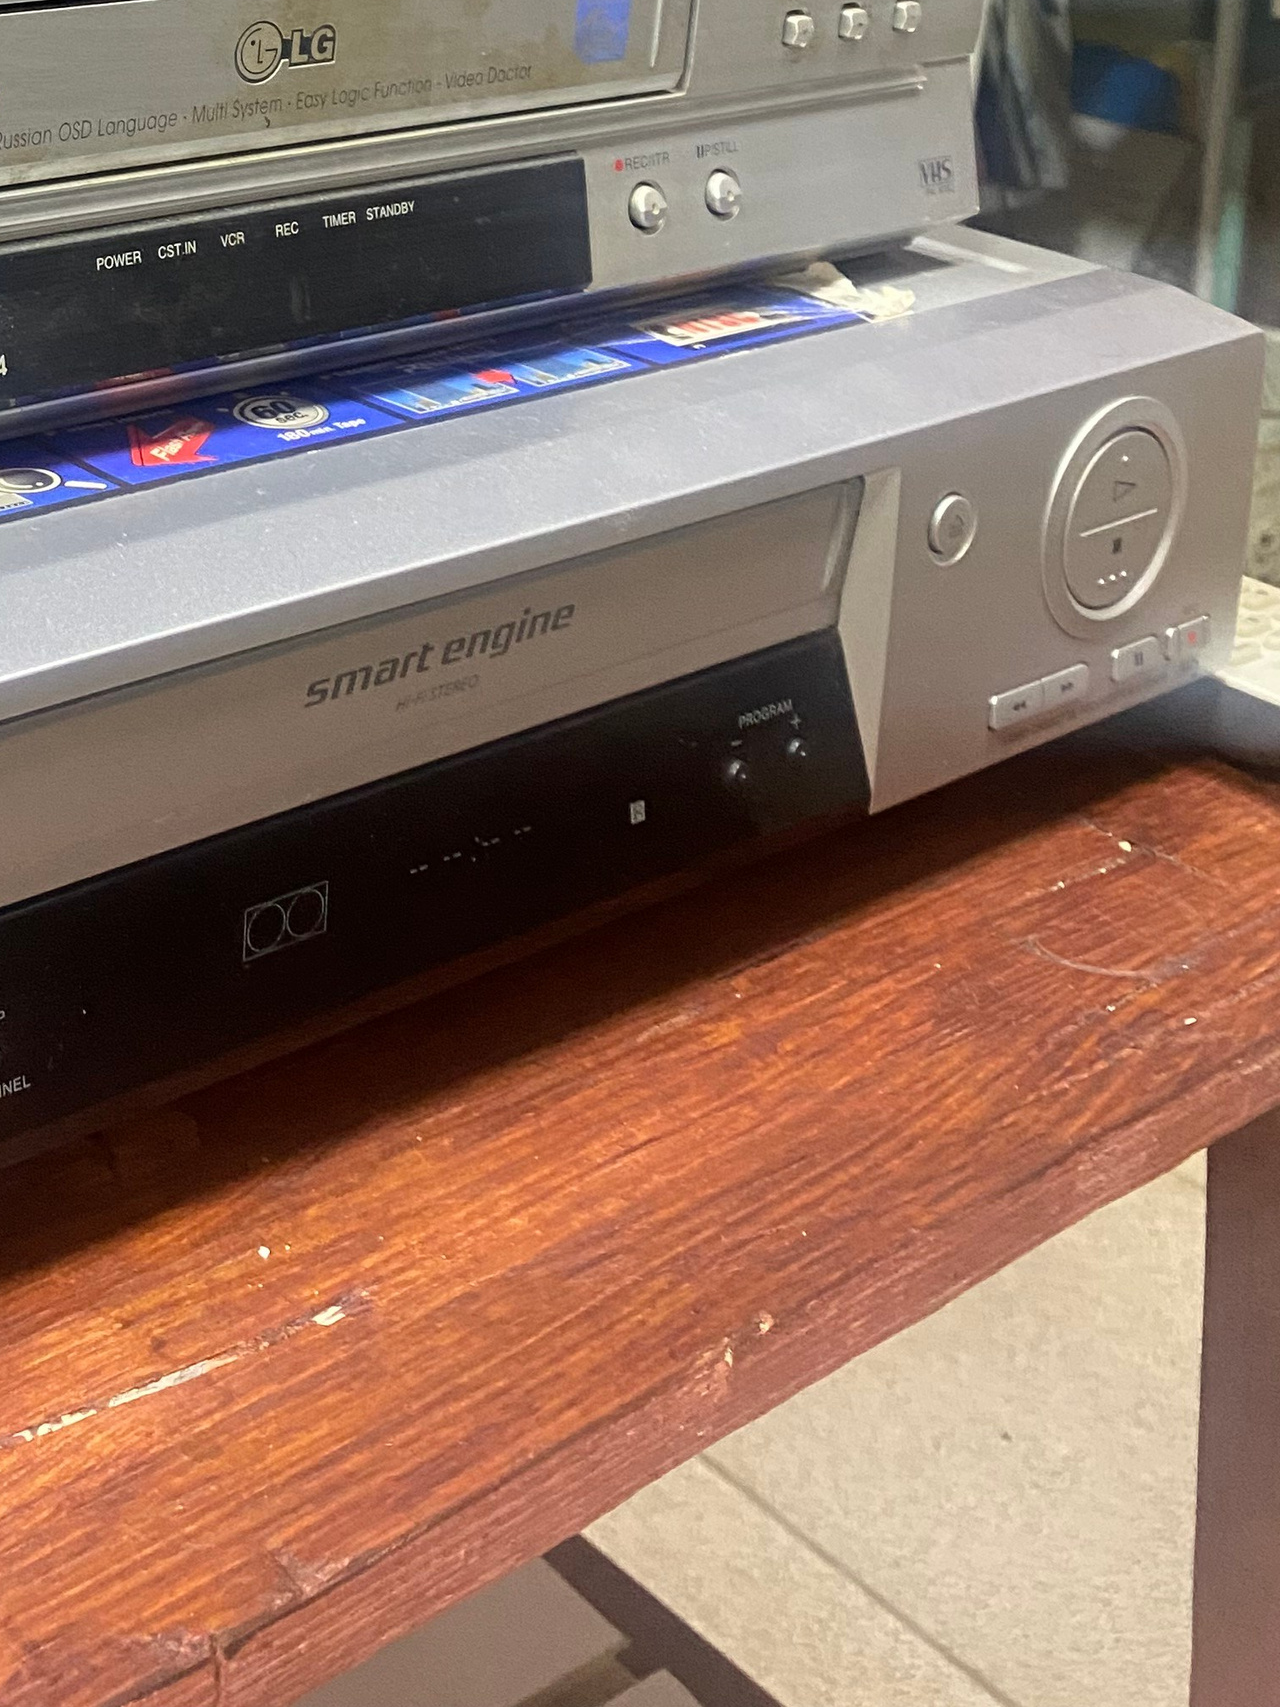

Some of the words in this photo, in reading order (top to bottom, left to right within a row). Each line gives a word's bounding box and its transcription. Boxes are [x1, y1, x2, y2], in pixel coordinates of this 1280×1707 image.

[288, 23, 338, 67] LG
[58, 120, 93, 142] OSD
[98, 111, 178, 138] Language
[192, 104, 229, 126] Multi
[232, 94, 283, 121] System
[295, 91, 330, 111] Easy
[332, 85, 369, 108] Logic
[374, 77, 433, 100] Function
[444, 67, 485, 91] Video
[488, 64, 533, 86] Doctor
[920, 157, 952, 186] VHS
[96, 250, 142, 271] POWER
[157, 240, 197, 259] CST.IN
[220, 231, 246, 248] VCR
[275, 221, 300, 238] REC
[322, 210, 357, 229] TIMER
[365, 200, 416, 221] STANDBY
[250, 400, 297, 420] 60
[332, 417, 367, 430] Tape
[304, 641, 435, 708] smart
[440, 603, 576, 665] engine
[738, 699, 793, 729] PROGRAM
